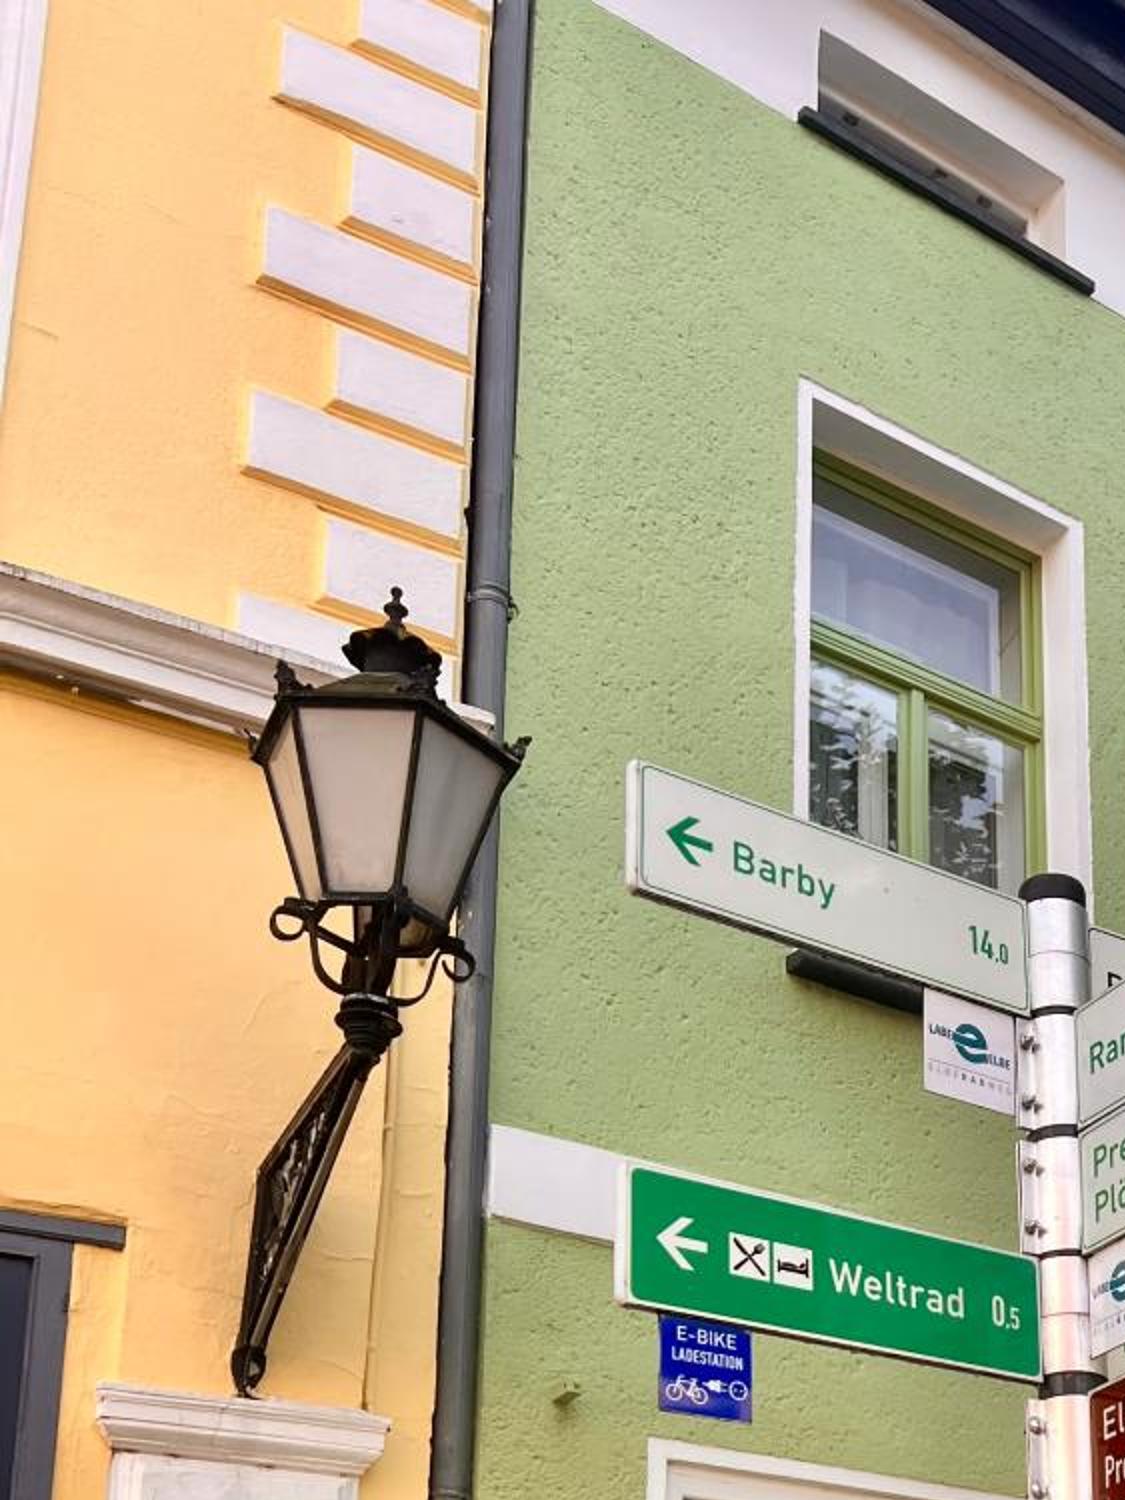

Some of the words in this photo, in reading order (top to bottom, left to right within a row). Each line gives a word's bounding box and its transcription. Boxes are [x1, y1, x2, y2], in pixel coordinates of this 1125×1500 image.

[733, 841, 835, 909] Barby
[828, 1257, 965, 1319] Weltrad
[991, 1294, 1021, 1331] 0.5
[671, 1345, 743, 1372] LADESTATION
[677, 1324, 737, 1351] E-BIKE
